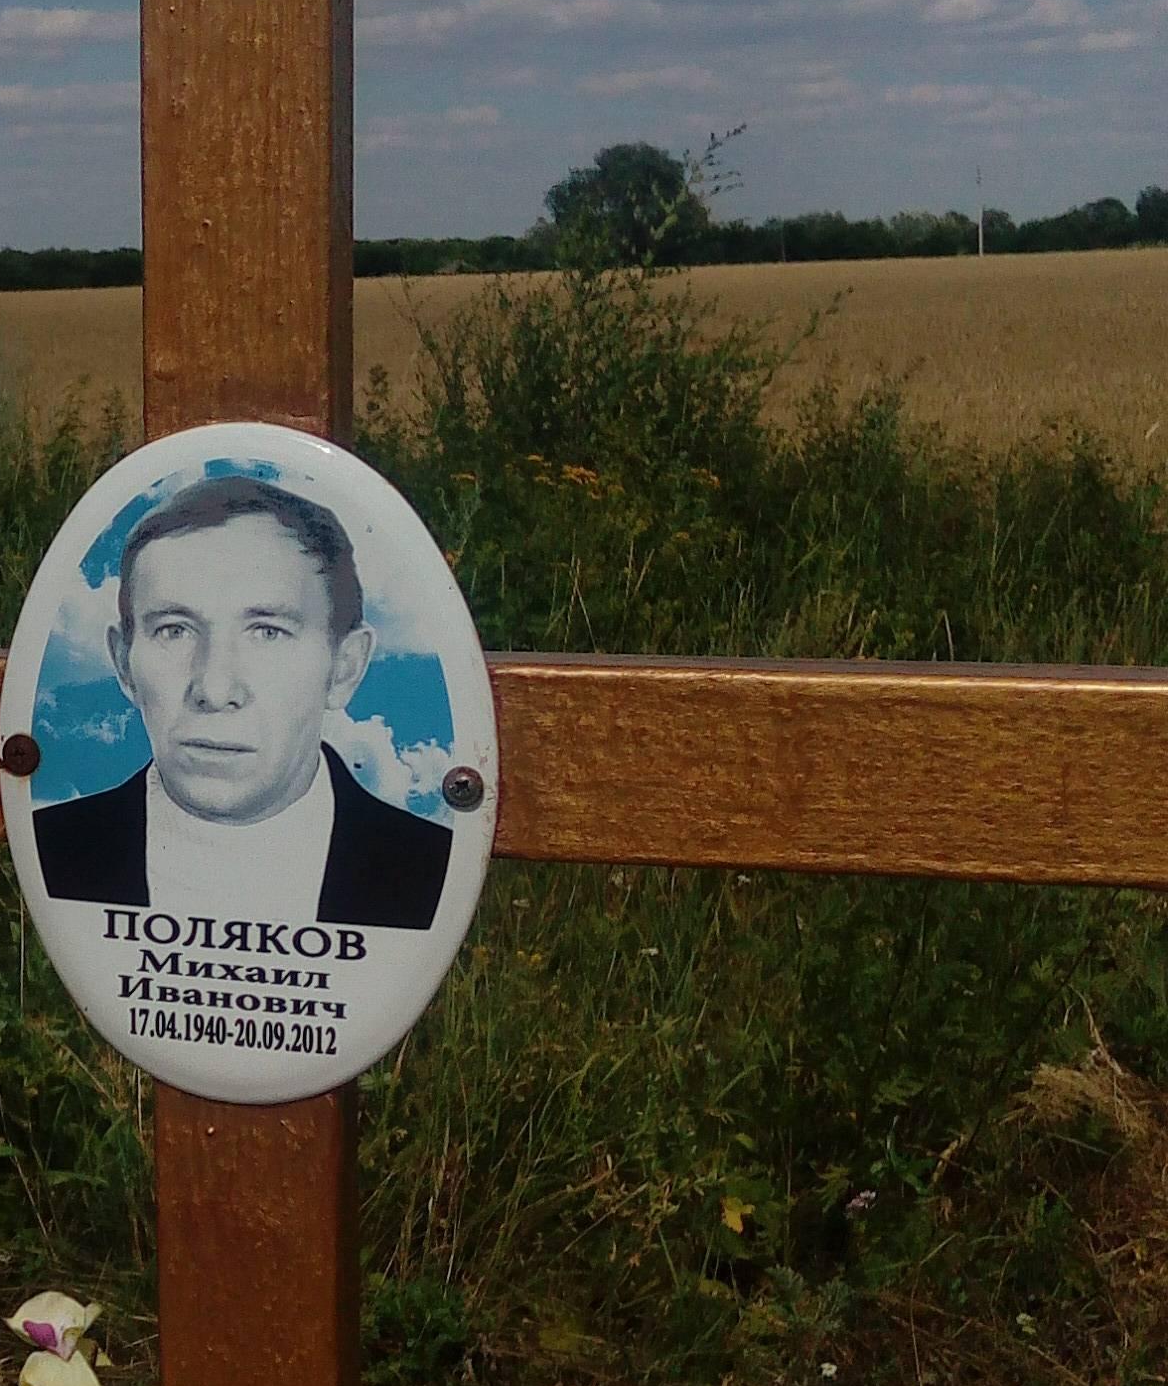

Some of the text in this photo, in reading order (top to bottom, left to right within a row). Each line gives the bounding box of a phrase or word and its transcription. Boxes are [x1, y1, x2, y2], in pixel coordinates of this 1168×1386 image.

[103, 909, 367, 960] ПОЛЯКОВ
[136, 949, 331, 989] Михаил
[117, 974, 347, 1020] Иванович
[129, 1007, 337, 1055] 17.04.1940-20.09.2012
